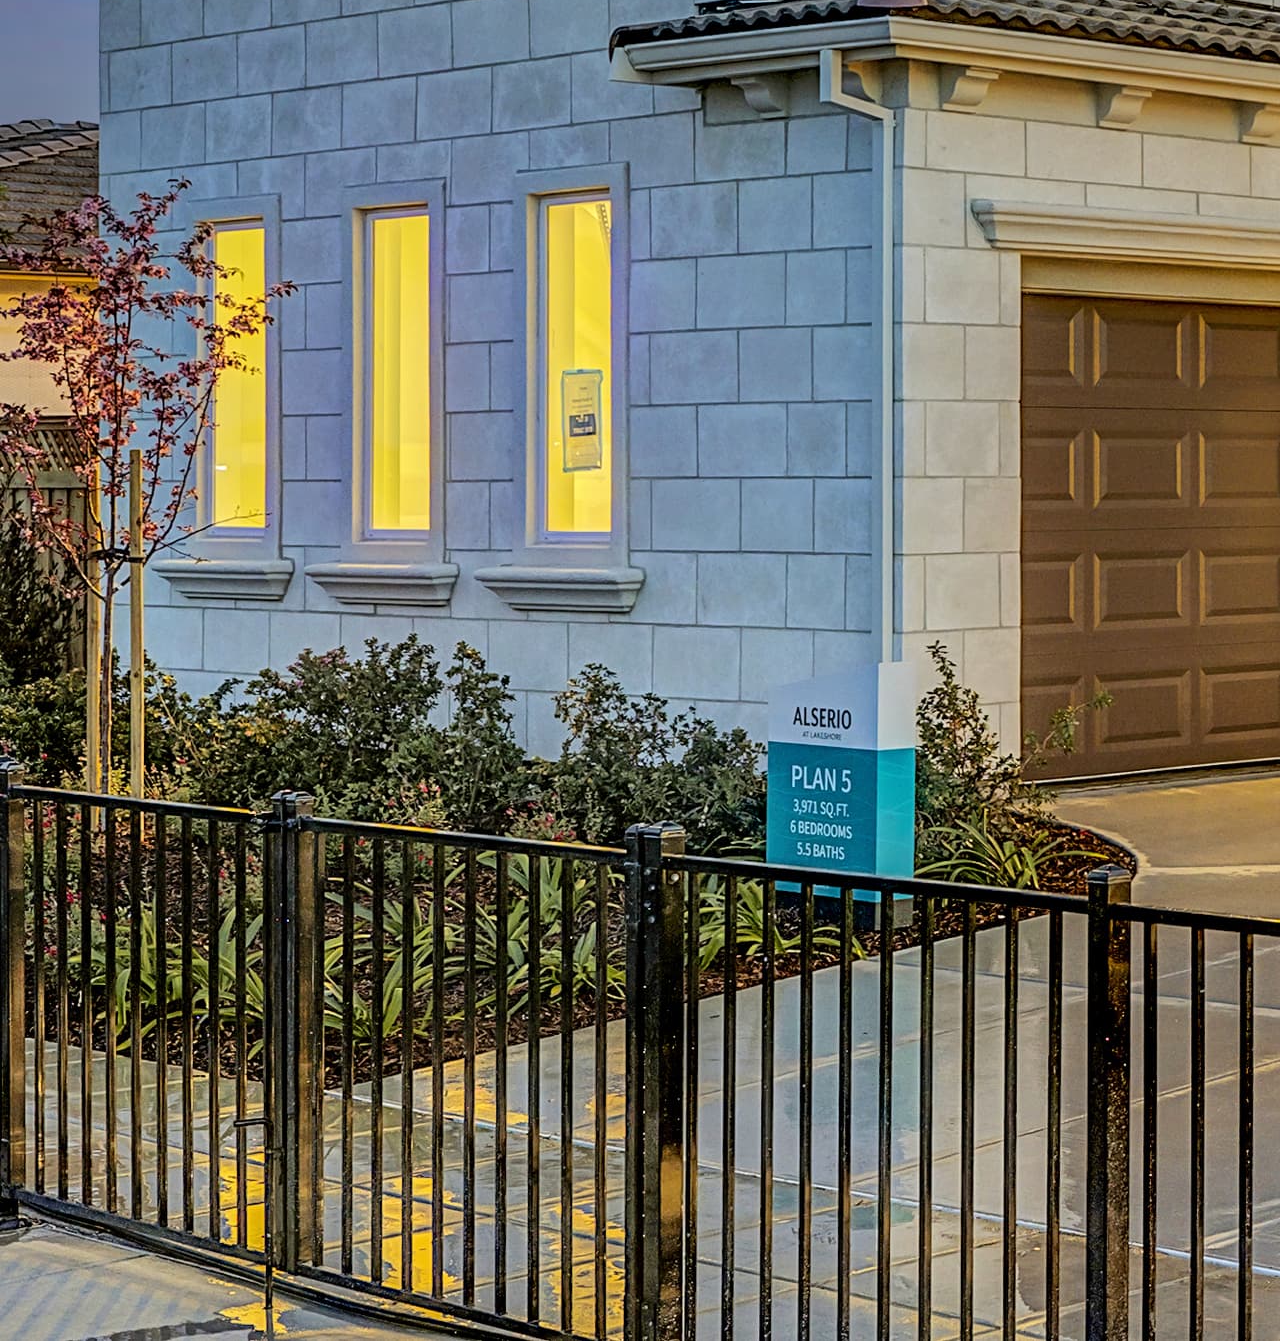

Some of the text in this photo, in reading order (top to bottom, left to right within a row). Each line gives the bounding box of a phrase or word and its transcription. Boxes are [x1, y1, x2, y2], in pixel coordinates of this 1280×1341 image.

[793, 706, 852, 730] ALSERIO
[791, 764, 851, 793] PLAN 5
[793, 798, 818, 815] 3,971
[790, 819, 853, 840] 6 BEDROOMS
[796, 842, 845, 861] 5.5 BATHS
